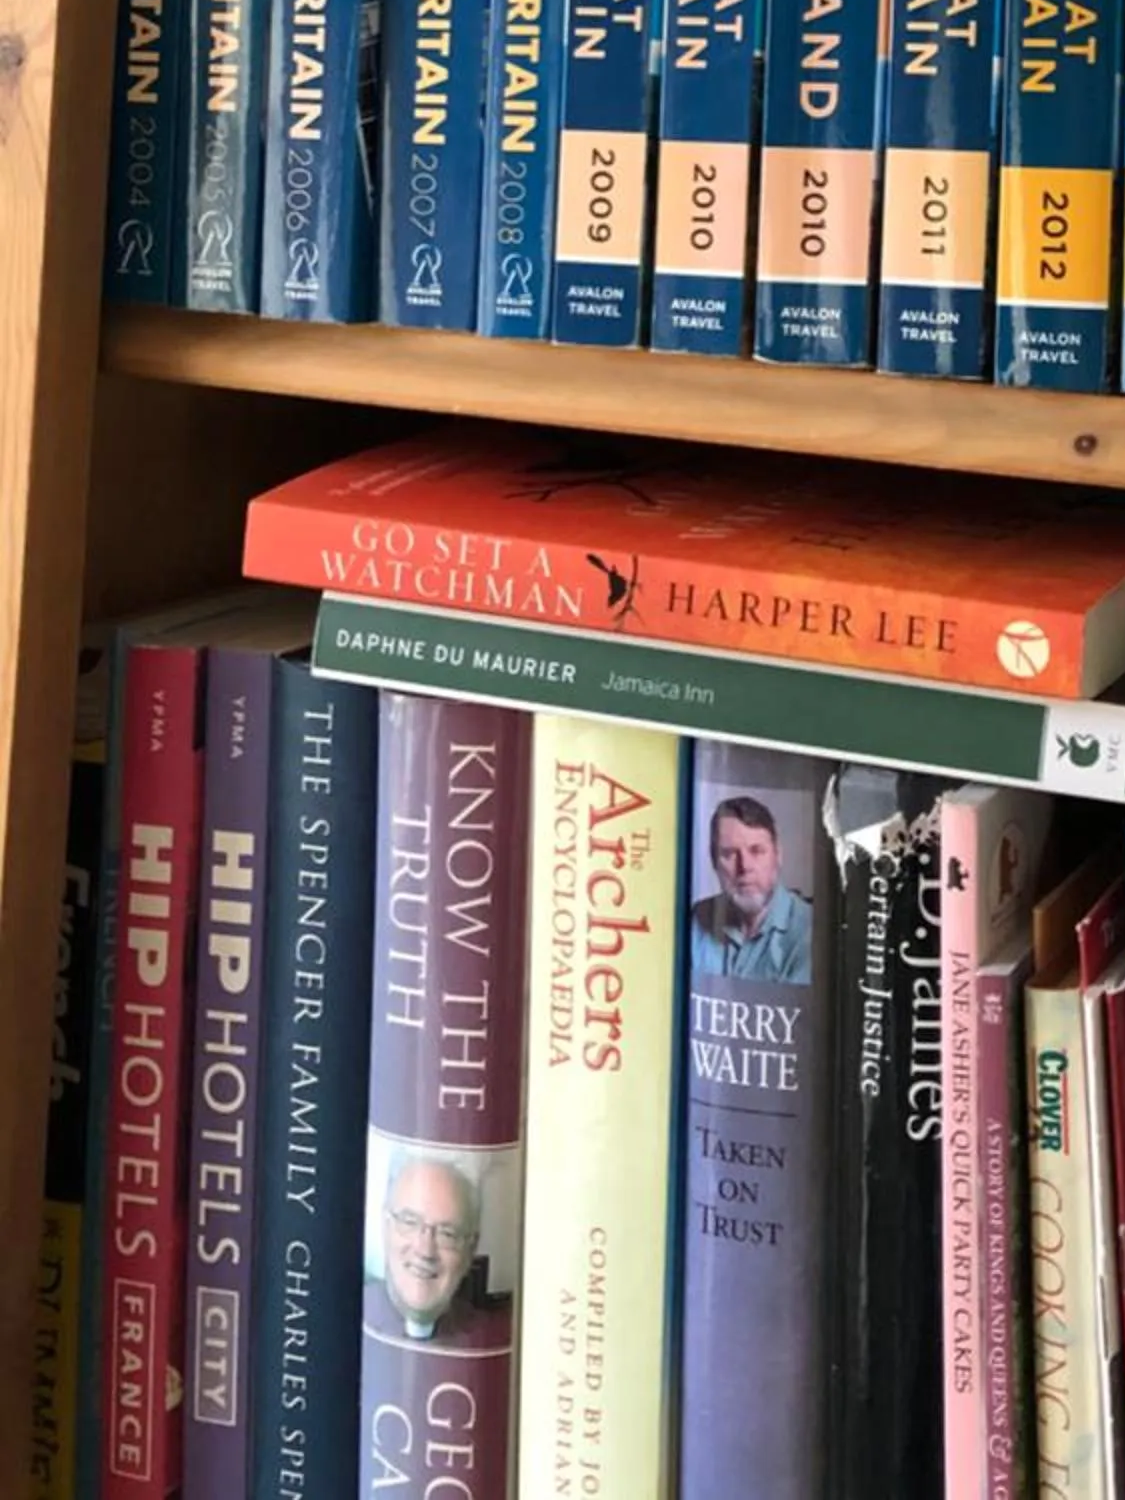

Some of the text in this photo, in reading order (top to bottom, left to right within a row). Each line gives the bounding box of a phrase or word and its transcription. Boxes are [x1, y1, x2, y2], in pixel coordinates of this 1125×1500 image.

[286, 149, 314, 232] 2006
[409, 153, 439, 238] 2007
[588, 148, 615, 243] 2009
[690, 164, 716, 250] 2010
[801, 169, 827, 257] 2010
[921, 178, 947, 256] 2011
[1040, 191, 1070, 280] 2012
[321, 550, 582, 618] WATCHMAN
[352, 520, 552, 579] GO SET A
[336, 629, 577, 684] DAPHNE DU MAURIER
[669, 582, 959, 654] HARPER LEE
[602, 671, 714, 704] Jamaica Inn
[630, 828, 651, 870] The
[386, 805, 431, 1030] TRUTH
[438, 741, 496, 1112] KNOW THE
[548, 759, 585, 1068] ENCYCLOPAEDIA
[583, 763, 651, 1073] Archers
[692, 993, 801, 1044] TERRY
[692, 1039, 798, 1091] WAITE
[1039, 1050, 1068, 1152] CLOVER
[116, 824, 173, 1465] HIP HOTELS FRANCE
[196, 830, 255, 1408] HIP HOTELS CITY
[696, 1126, 786, 1169] TAKEN
[697, 1203, 784, 1246] TRUST
[718, 1179, 759, 1203] ON
[952, 1219, 972, 1393] PARTY CAKES
